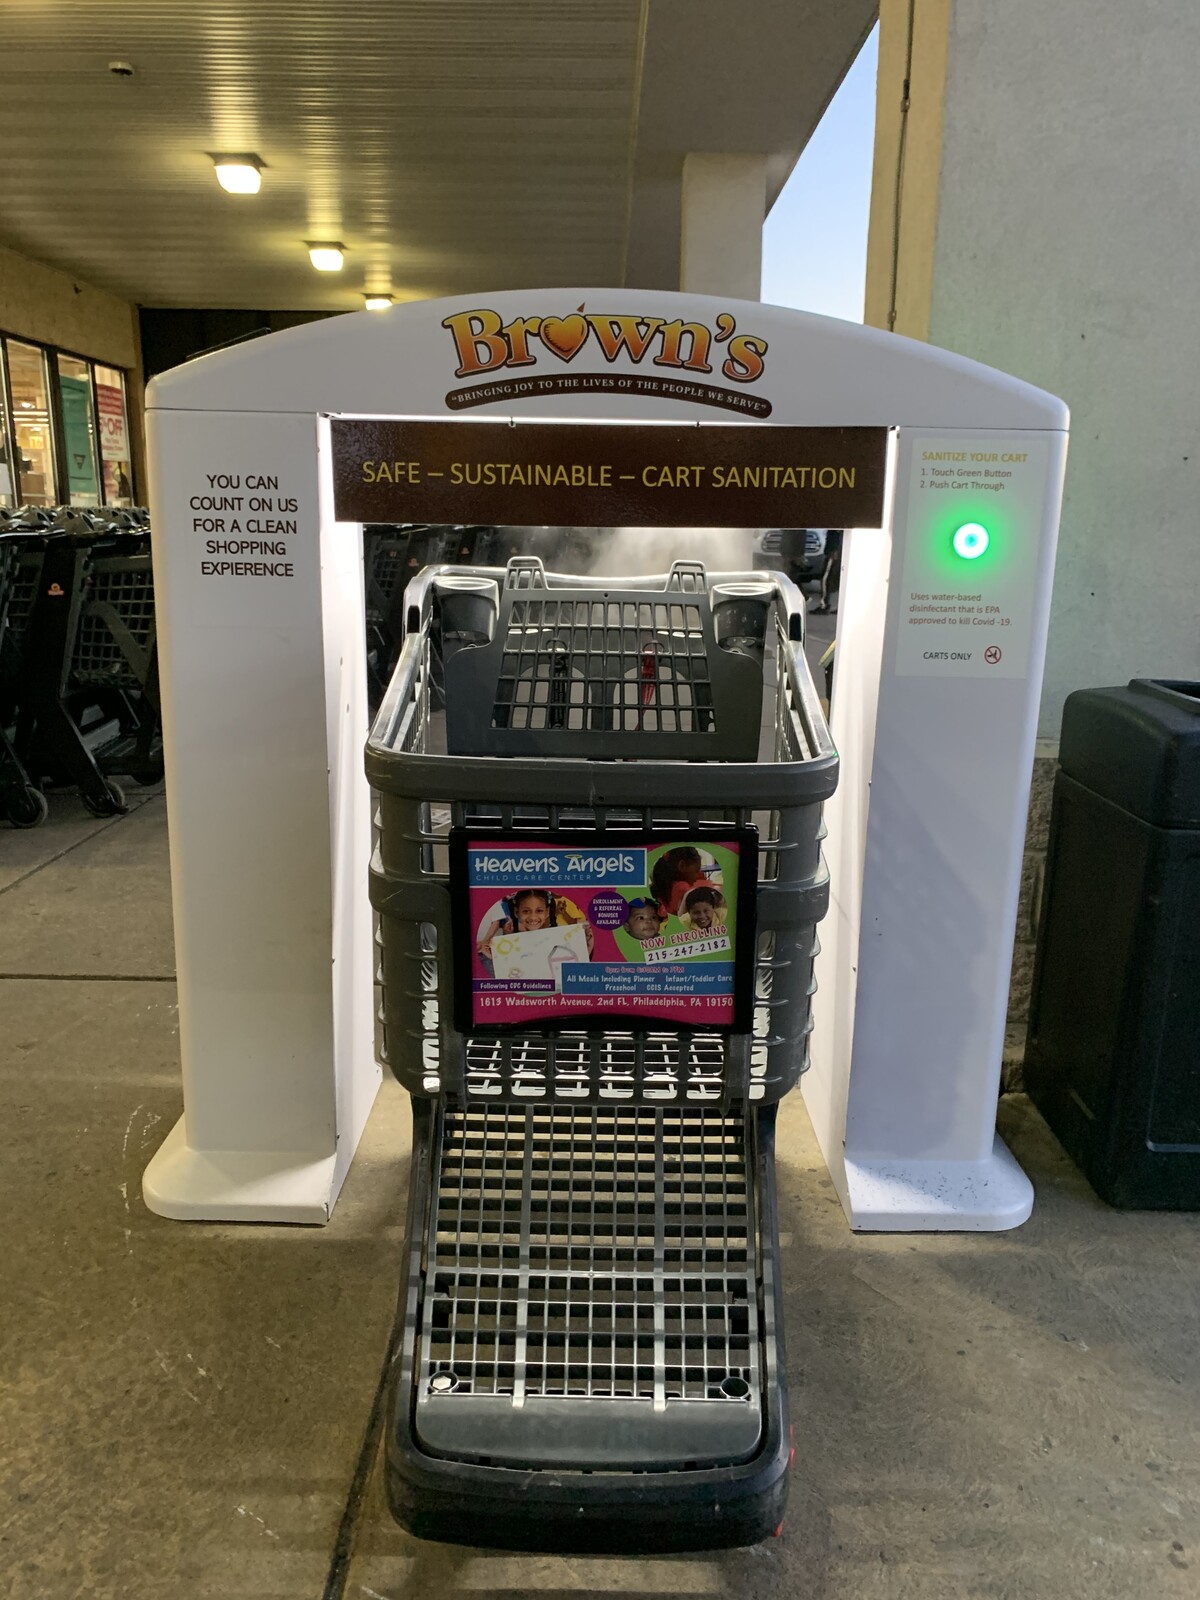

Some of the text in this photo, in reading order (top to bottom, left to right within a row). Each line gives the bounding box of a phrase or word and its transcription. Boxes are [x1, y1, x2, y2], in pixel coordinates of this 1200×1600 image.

[514, 381, 535, 394] JOY
[538, 380, 553, 389] TO
[557, 379, 579, 387] THE
[583, 378, 615, 388] LIVES
[618, 379, 633, 388] OF
[637, 380, 659, 390] THE
[662, 383, 704, 397] PEOPLE
[708, 390, 725, 401] WE
[922, 452, 1028, 462] SANITIZE YOUR CART
[362, 461, 421, 484] SAFE
[450, 463, 613, 487] SUSTAINABLE
[642, 466, 705, 488] CART
[711, 467, 856, 489] SANITATION
[921, 468, 1012, 478] 1. Touch Green Button
[206, 474, 279, 490] YOU CAN
[920, 480, 1005, 491] 2. Push Cart Through
[189, 496, 299, 513] COUNT ON US
[193, 518, 297, 534] FOR A CLEAN
[206, 540, 287, 556] SHOPPING
[201, 561, 294, 577] EXPIERENCE
[931, 593, 982, 602] water-based
[909, 605, 957, 613] disinfectant
[958, 605, 975, 613] that
[985, 606, 1000, 614] EPA
[908, 617, 947, 625] approved
[972, 618, 995, 626] Covid
[923, 652, 973, 661] CARTS ONLY
[475, 853, 635, 878] Heavens Angels
[640, 925, 728, 950] NOW ENROLLING
[647, 939, 727, 962] 215-247-2182
[566, 975, 576, 983] All
[578, 975, 599, 983] Meals
[601, 975, 631, 984] Including
[633, 975, 656, 983] Dinner
[665, 974, 715, 983] Infant/Toddler
[605, 984, 637, 992] Preschool
[664, 984, 694, 993] Accepted
[505, 997, 557, 1007] Wadsworth
[560, 997, 594, 1007] Avenue,
[596, 997, 614, 1006] 2nd
[617, 997, 630, 1007] FL,
[633, 997, 687, 1008] Philadelphia,
[690, 997, 702, 1007] PA
[706, 997, 733, 1007] 19150
